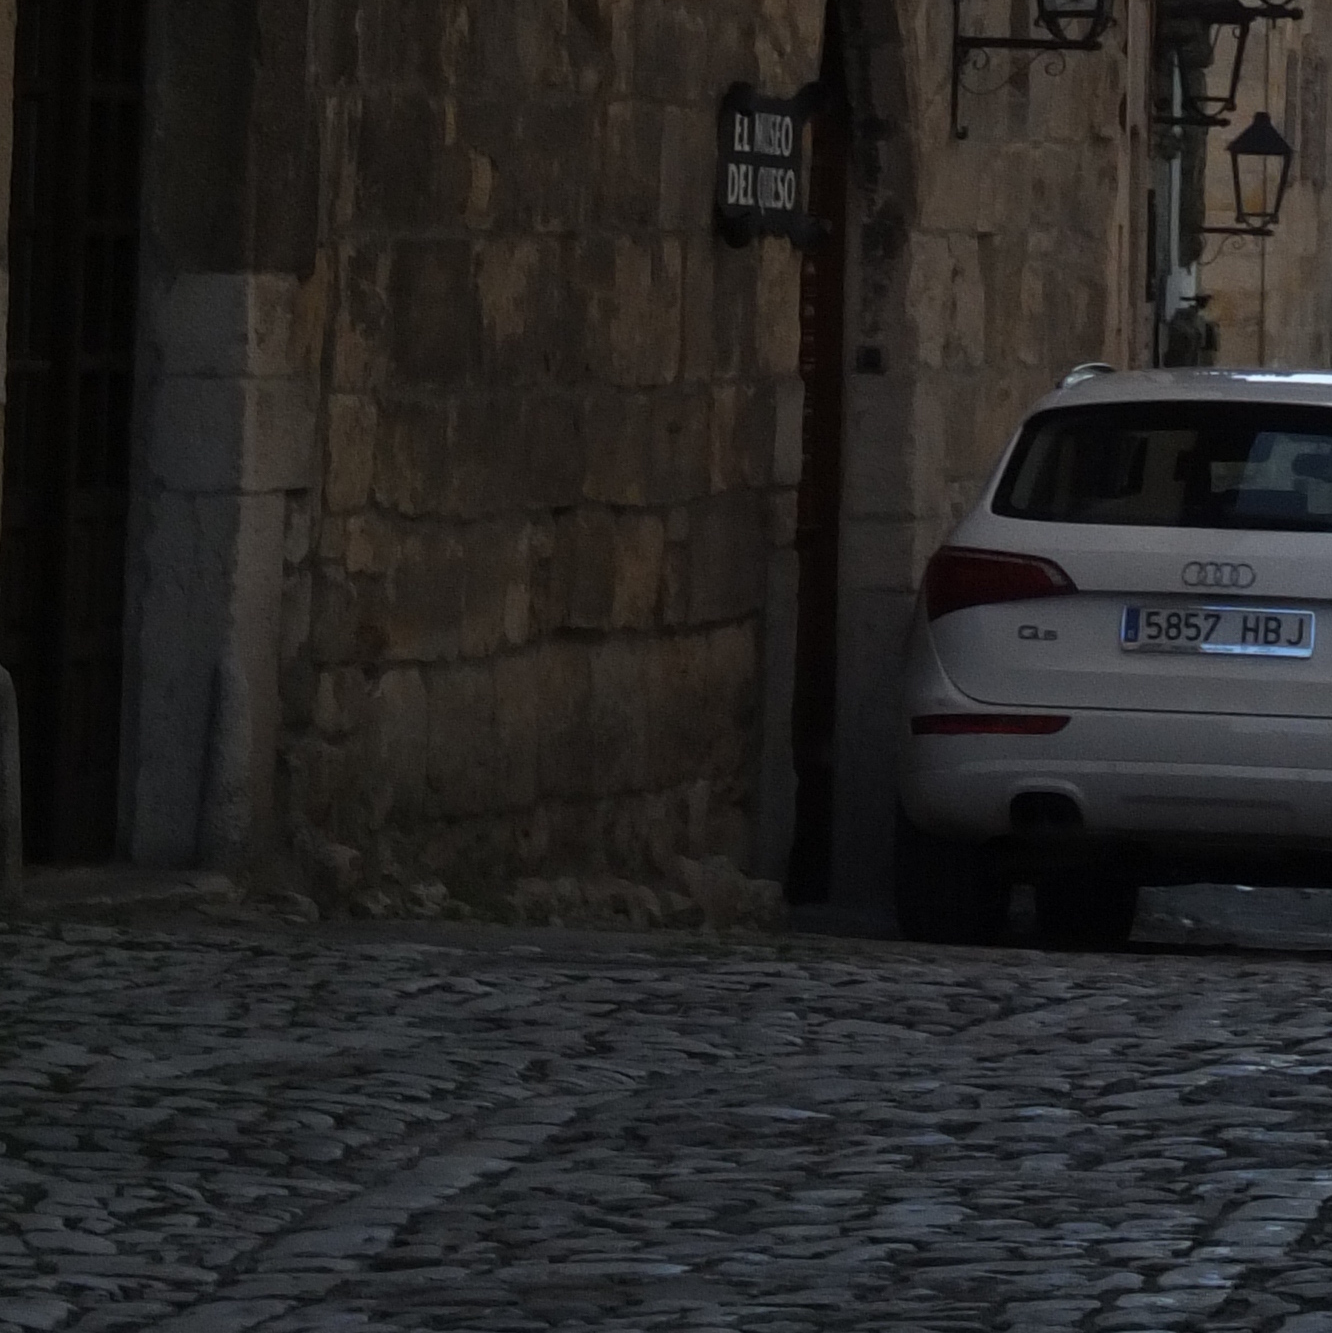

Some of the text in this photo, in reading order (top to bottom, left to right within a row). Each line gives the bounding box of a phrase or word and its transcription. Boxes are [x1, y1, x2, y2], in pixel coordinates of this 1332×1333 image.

[734, 111, 793, 158] EL MUSEO
[727, 162, 796, 216] DEL QUESO
[1145, 610, 1304, 646] 5857 HBJ
